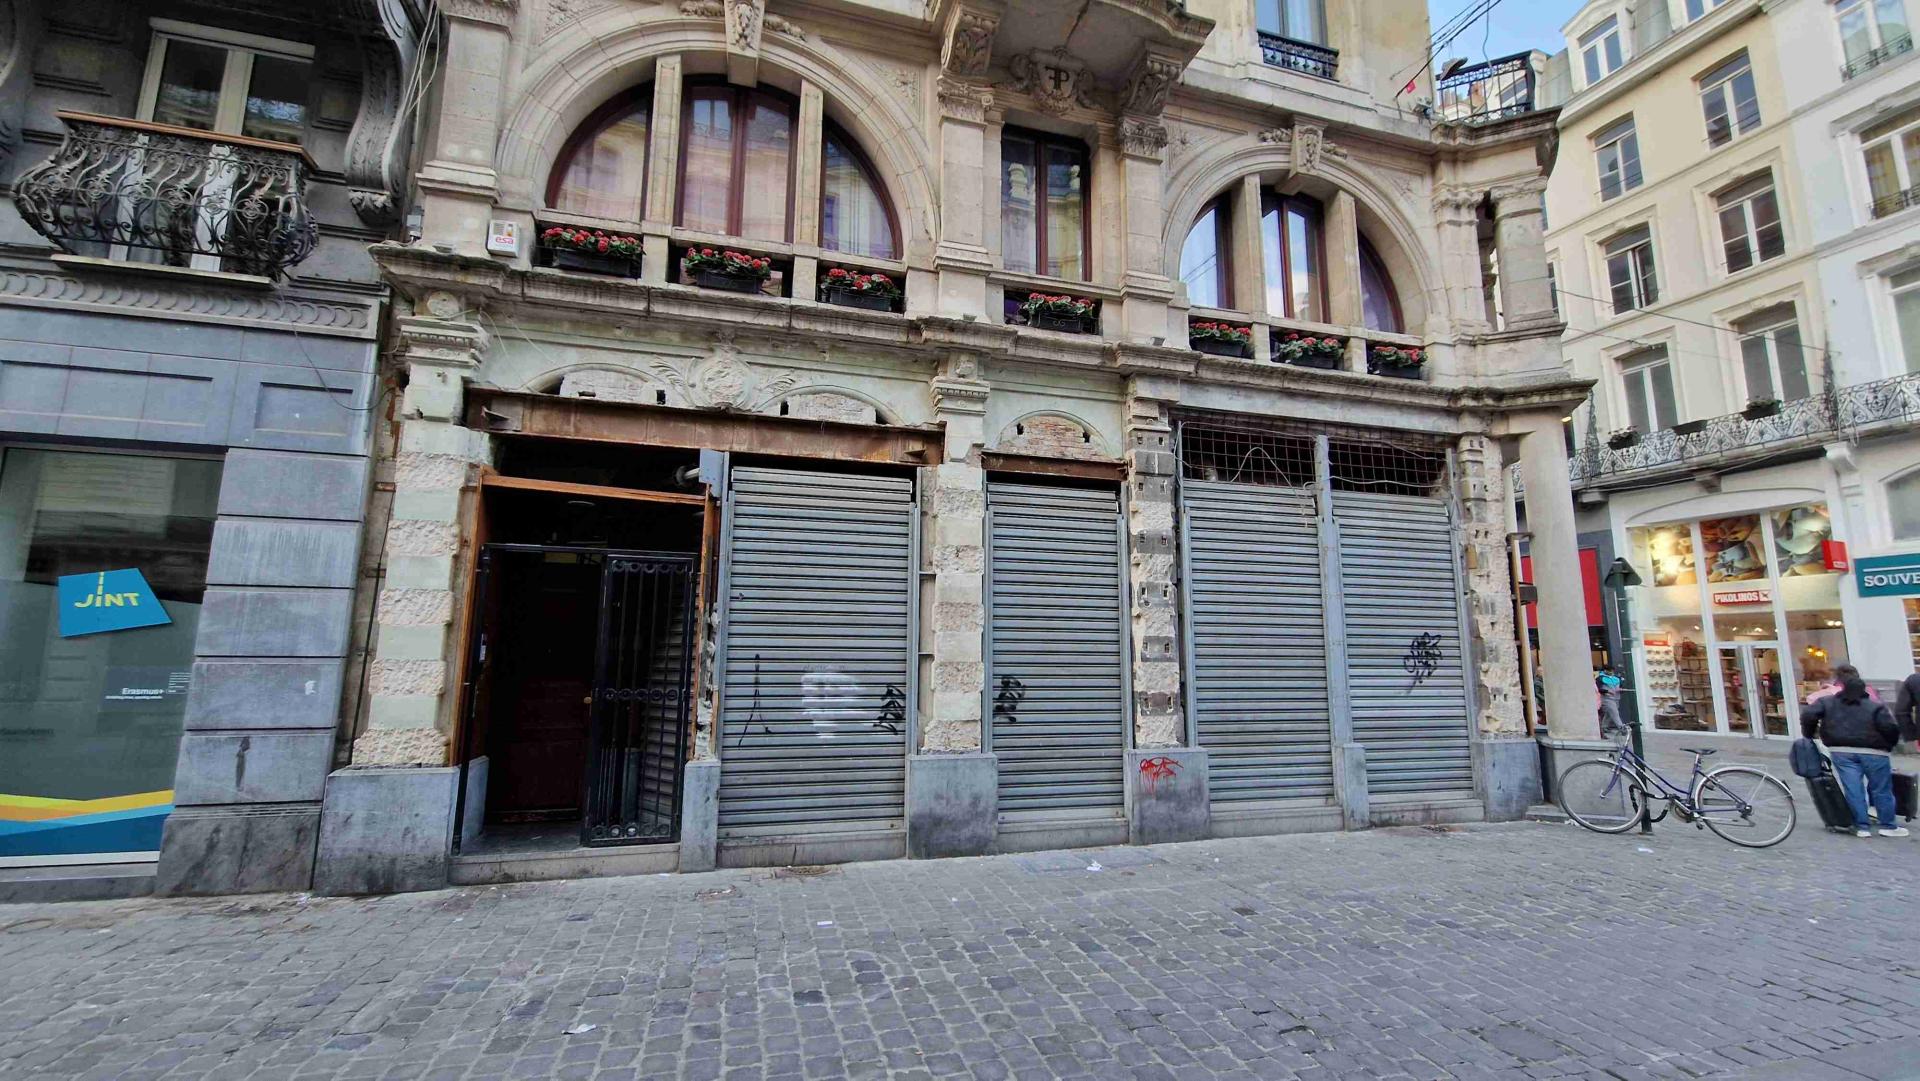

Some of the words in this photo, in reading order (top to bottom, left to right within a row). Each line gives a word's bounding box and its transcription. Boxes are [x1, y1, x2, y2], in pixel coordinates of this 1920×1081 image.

[1863, 572, 1920, 588] SOUVE
[1714, 592, 1759, 603] PIKOLINOS
[121, 687, 164, 695] Erasmus+
